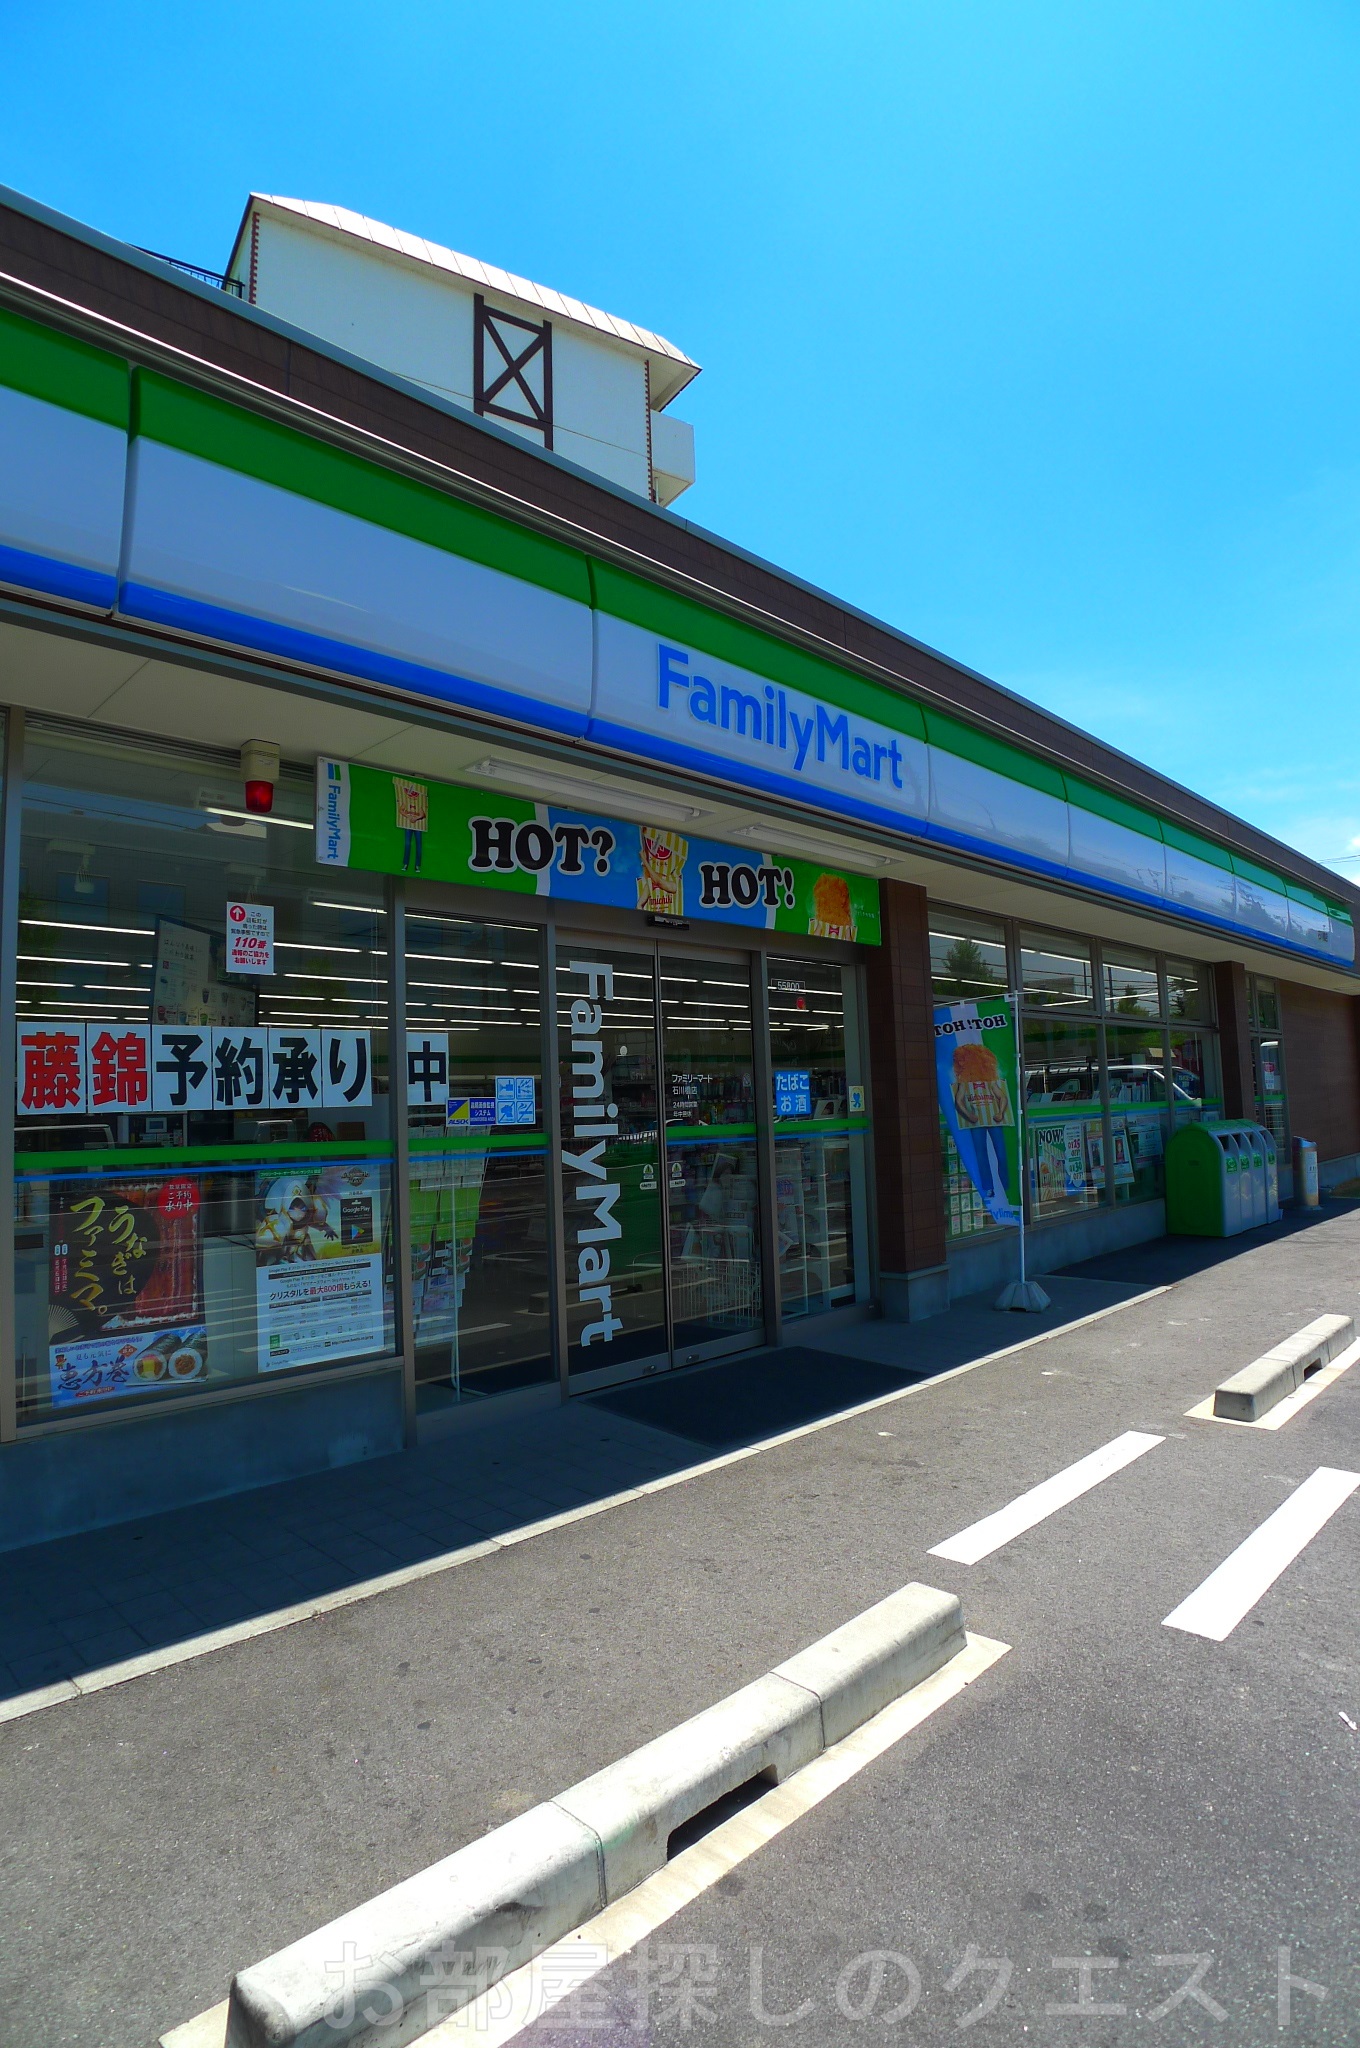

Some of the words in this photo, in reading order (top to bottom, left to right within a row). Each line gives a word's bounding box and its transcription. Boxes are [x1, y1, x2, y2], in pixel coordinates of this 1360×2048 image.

[658, 643, 903, 789] FamilyMart
[327, 784, 342, 860] FamilyMart
[472, 820, 613, 873] HOT?
[700, 864, 793, 906] HOT!
[235, 937, 267, 949] 110番
[232, 949, 269, 958] 通報のご協力を
[234, 957, 267, 965] お願いします
[671, 1073, 714, 1084] ファミリーマート
[776, 1073, 810, 1091] たばこ
[780, 1094, 807, 1113] お酒
[474, 1109, 492, 1117] システム
[1039, 1127, 1064, 1145] NOW!
[561, 960, 624, 1348] FamilyMart
[164, 1199, 194, 1213] 承り中
[342, 1206, 361, 1214] Google
[360, 1205, 371, 1213] Play
[109, 1205, 149, 1295] うなぎは
[58, 1354, 131, 1391] 恵方巻
